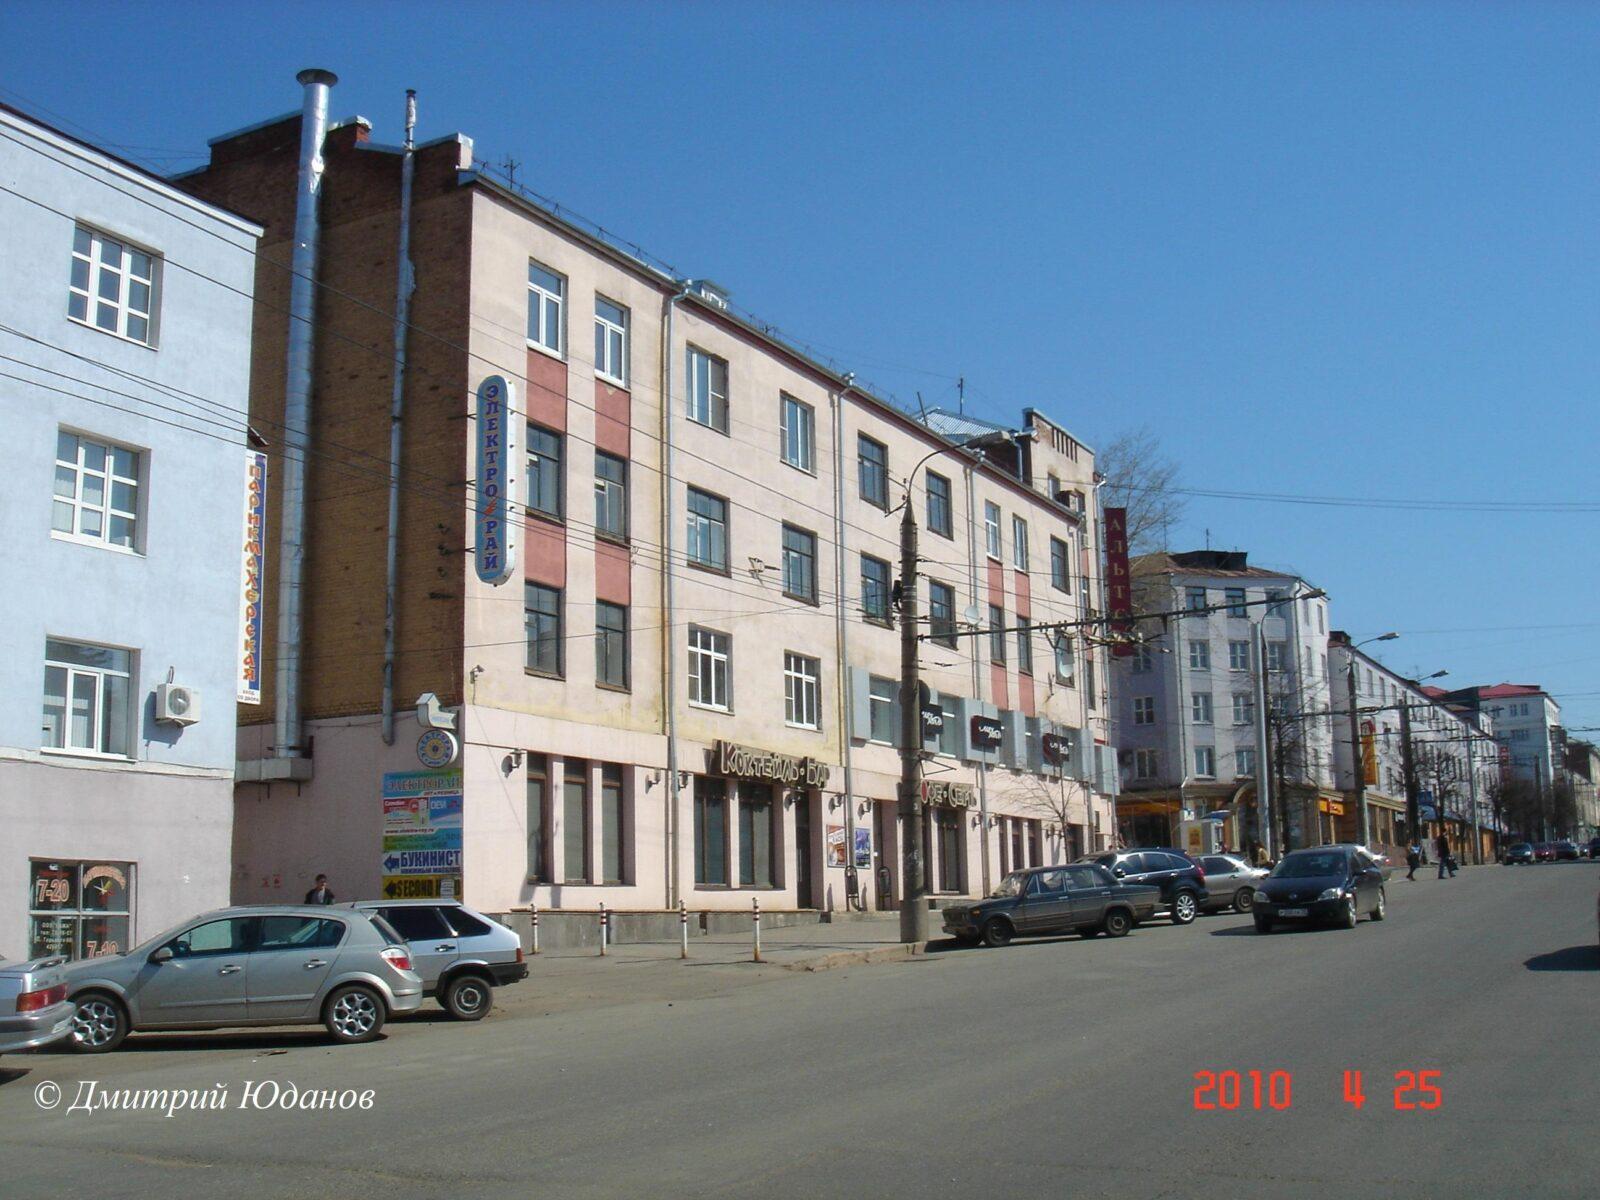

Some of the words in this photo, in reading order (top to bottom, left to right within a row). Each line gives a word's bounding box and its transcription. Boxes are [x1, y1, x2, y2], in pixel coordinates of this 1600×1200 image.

[400, 850, 461, 867] БУКИНИСТ
[36, 878, 70, 903] 7-20
[396, 879, 433, 897] SECOND
